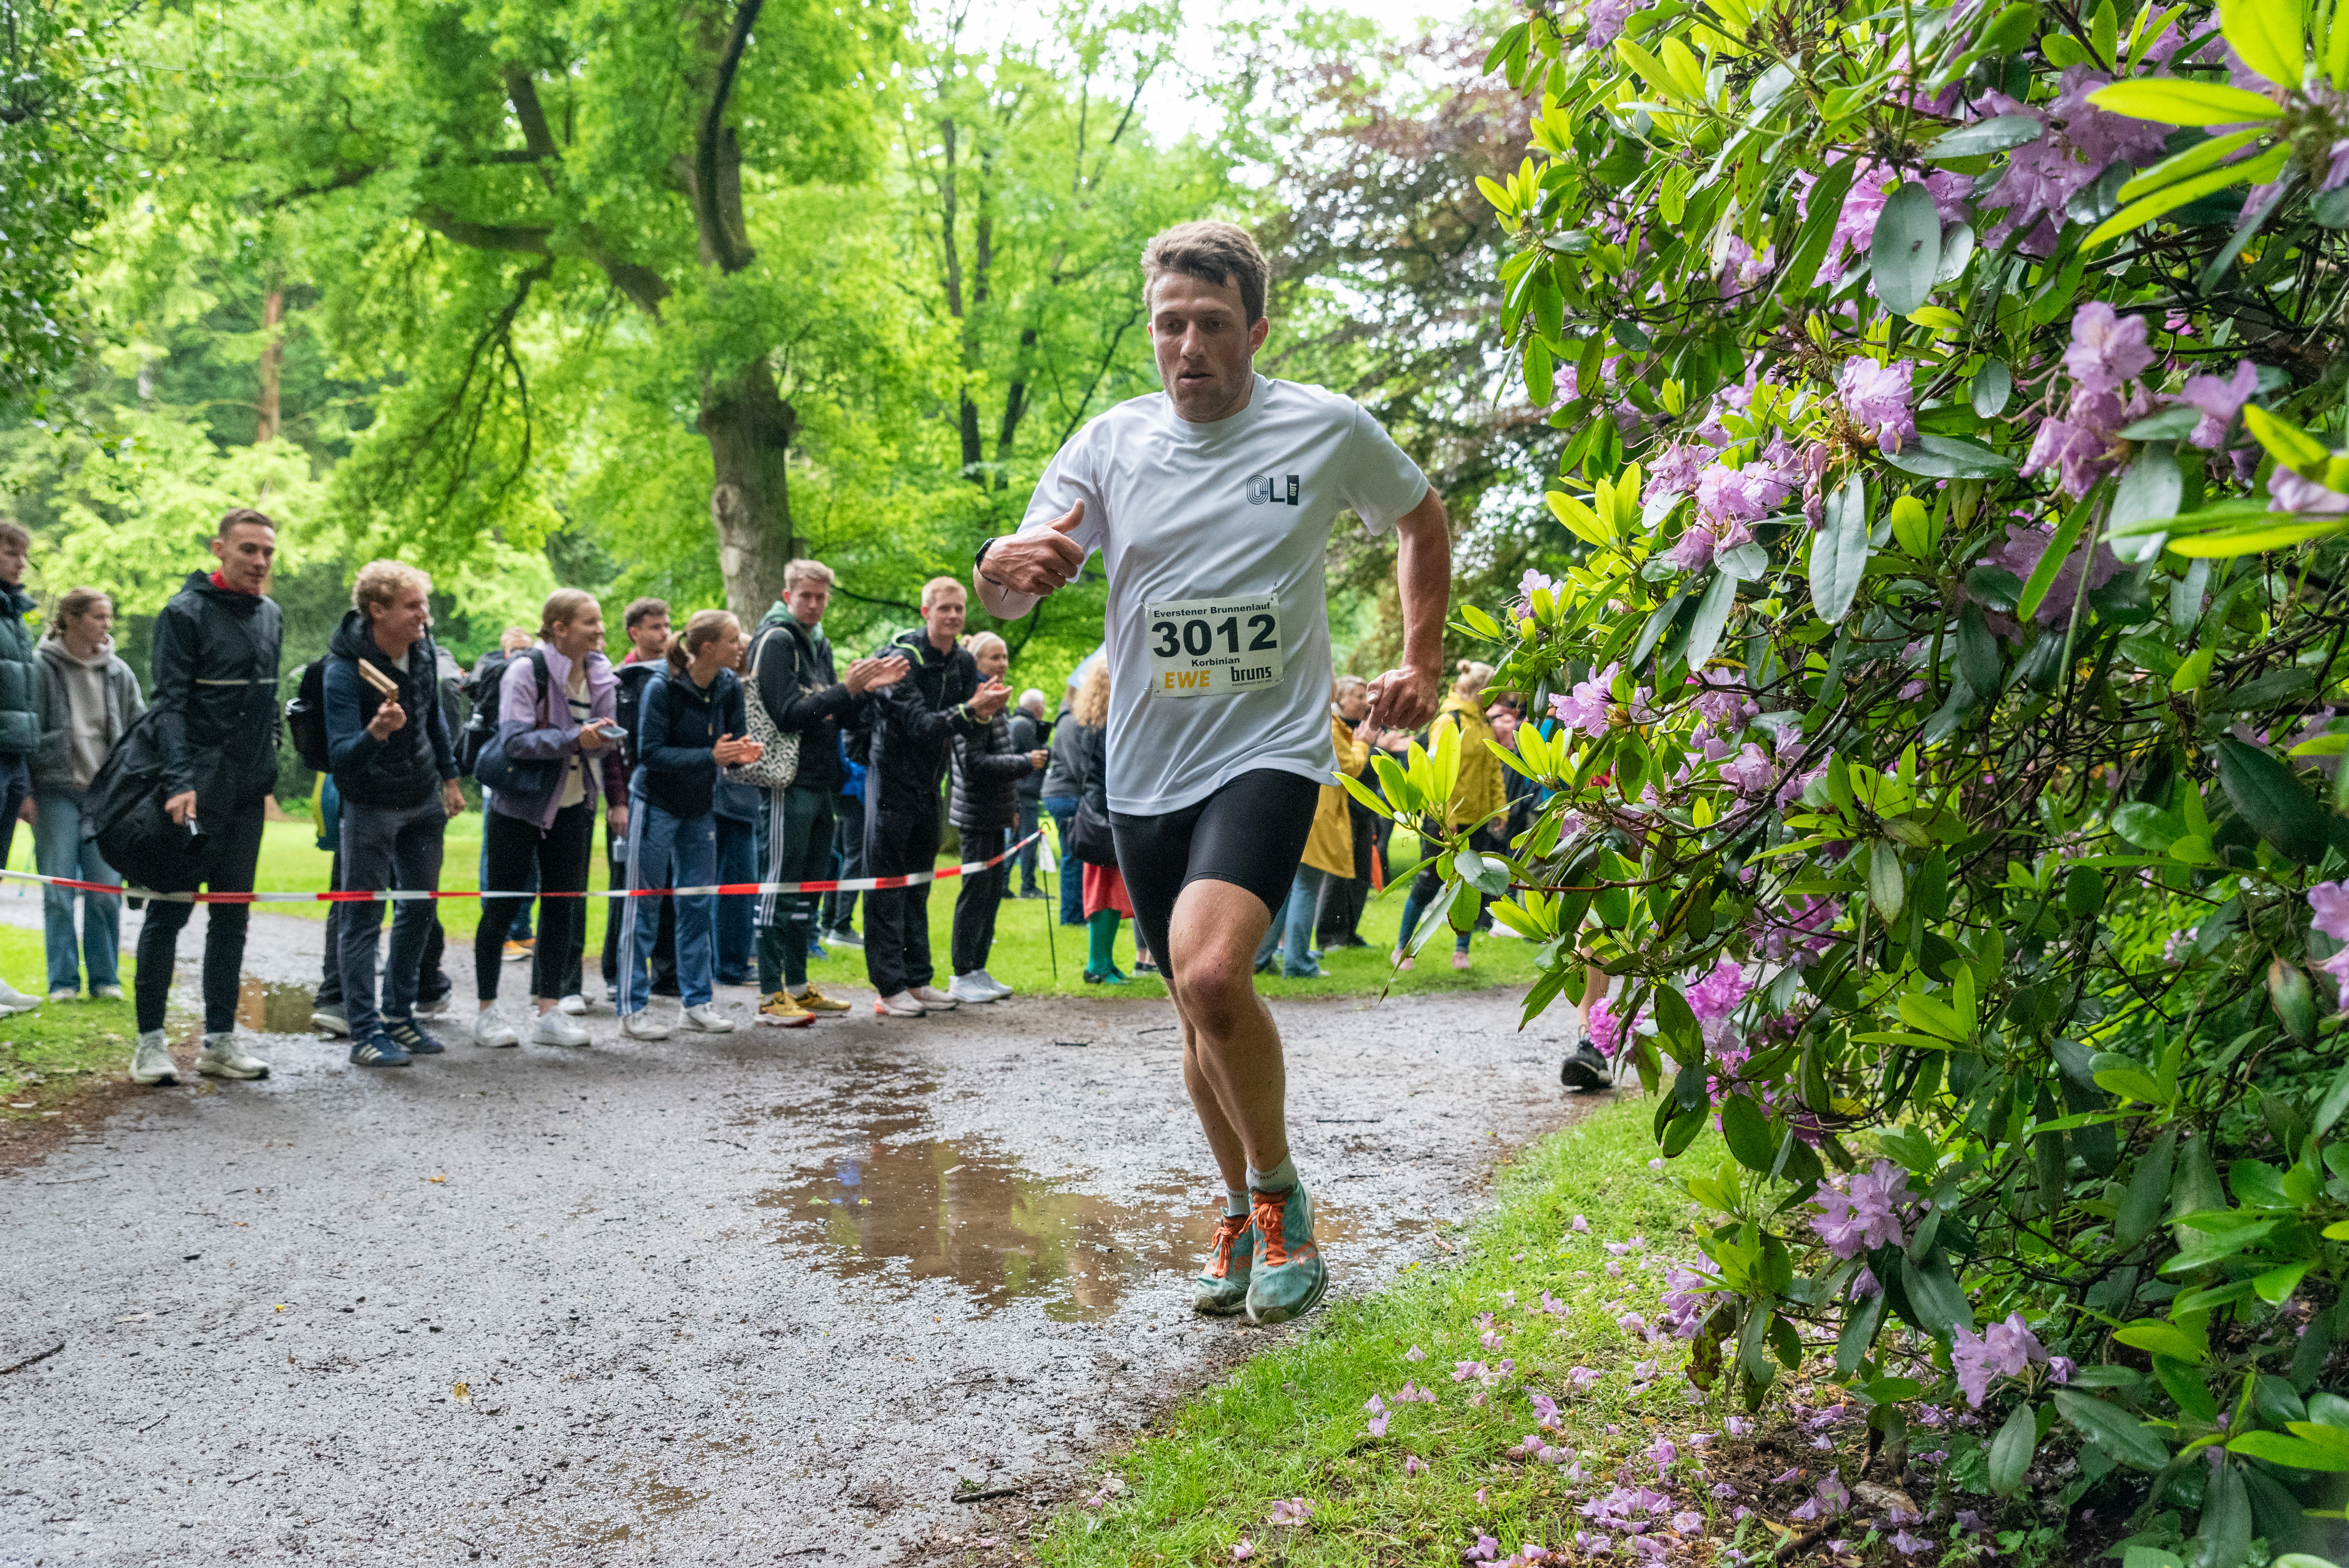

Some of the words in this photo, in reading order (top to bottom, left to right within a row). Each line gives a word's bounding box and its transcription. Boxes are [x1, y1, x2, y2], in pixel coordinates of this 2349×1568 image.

[1154, 608, 1207, 618] Everstener
[1210, 602, 1271, 614] Brunnenlauf
[1152, 614, 1277, 658] 3012
[1191, 657, 1240, 667] Korbinian
[1165, 670, 1211, 689] EWE
[1230, 666, 1272, 682] bruns
